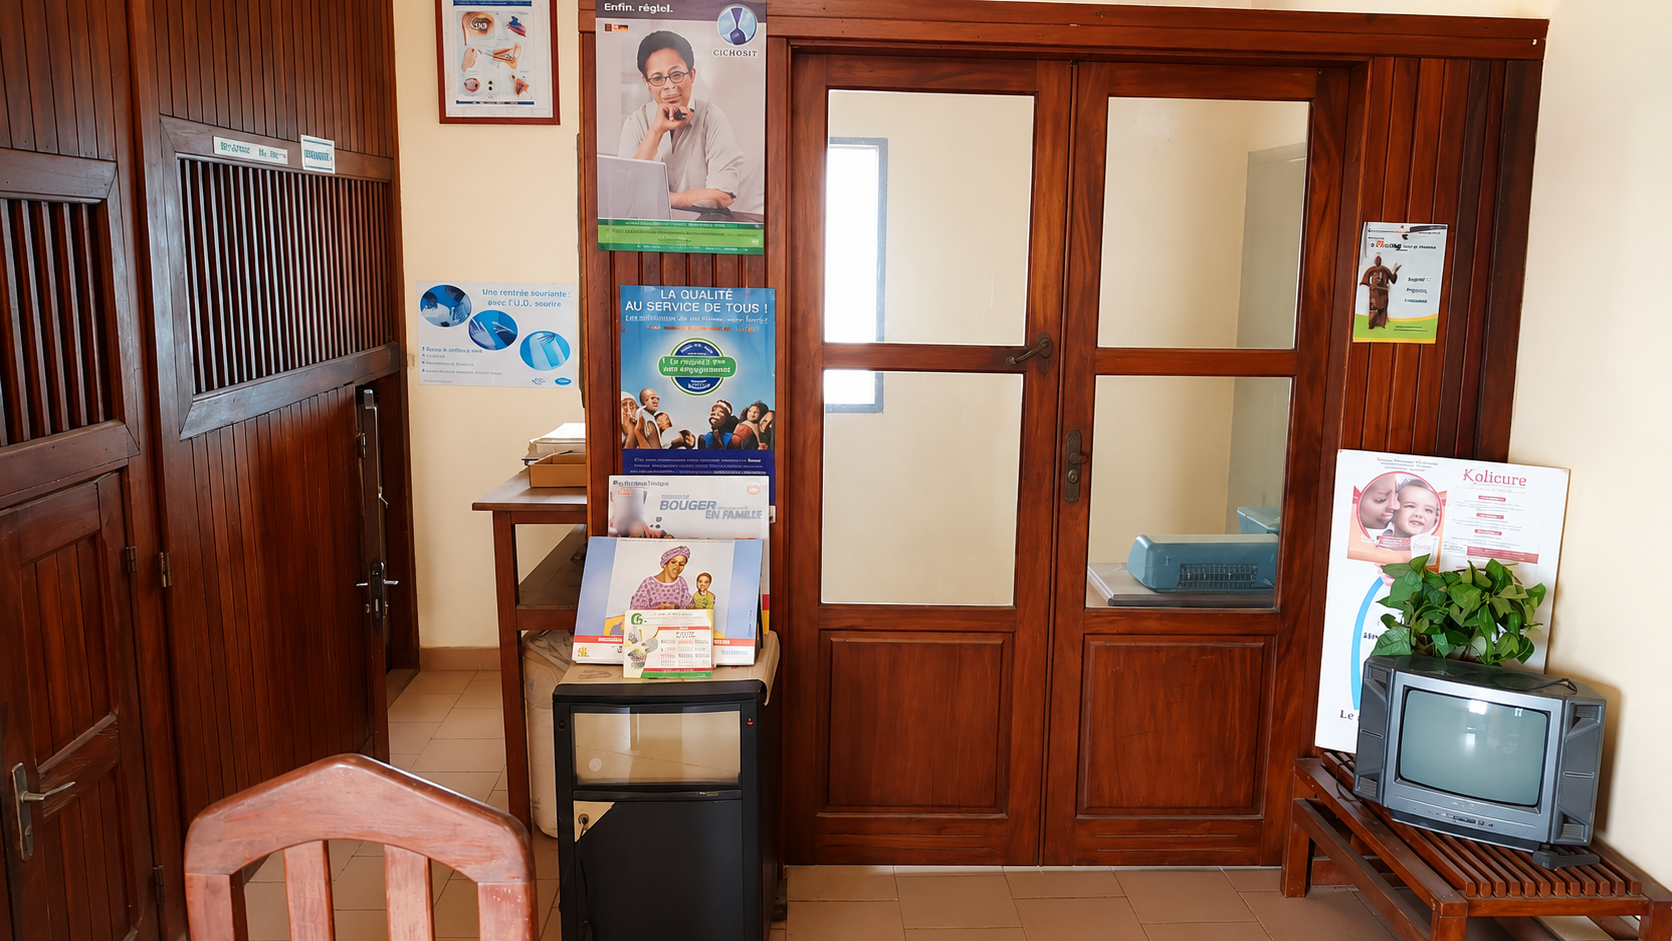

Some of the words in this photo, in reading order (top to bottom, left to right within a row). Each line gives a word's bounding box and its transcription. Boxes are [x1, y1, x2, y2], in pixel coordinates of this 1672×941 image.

[604, 3, 635, 12] Enfin.
[482, 288, 498, 296] Une
[500, 289, 529, 297] rentrée
[530, 290, 567, 298] souriante
[660, 289, 677, 300] LA
[680, 288, 733, 300] QUALITÉ
[625, 301, 642, 311] AU
[646, 301, 700, 312] SERVICE
[704, 302, 722, 313] DE
[725, 303, 760, 314] TOUS
[1463, 468, 1527, 486] Kolicure
[659, 500, 717, 511] BOUGER
[705, 509, 721, 520] EN
[1339, 709, 1354, 720] Le
